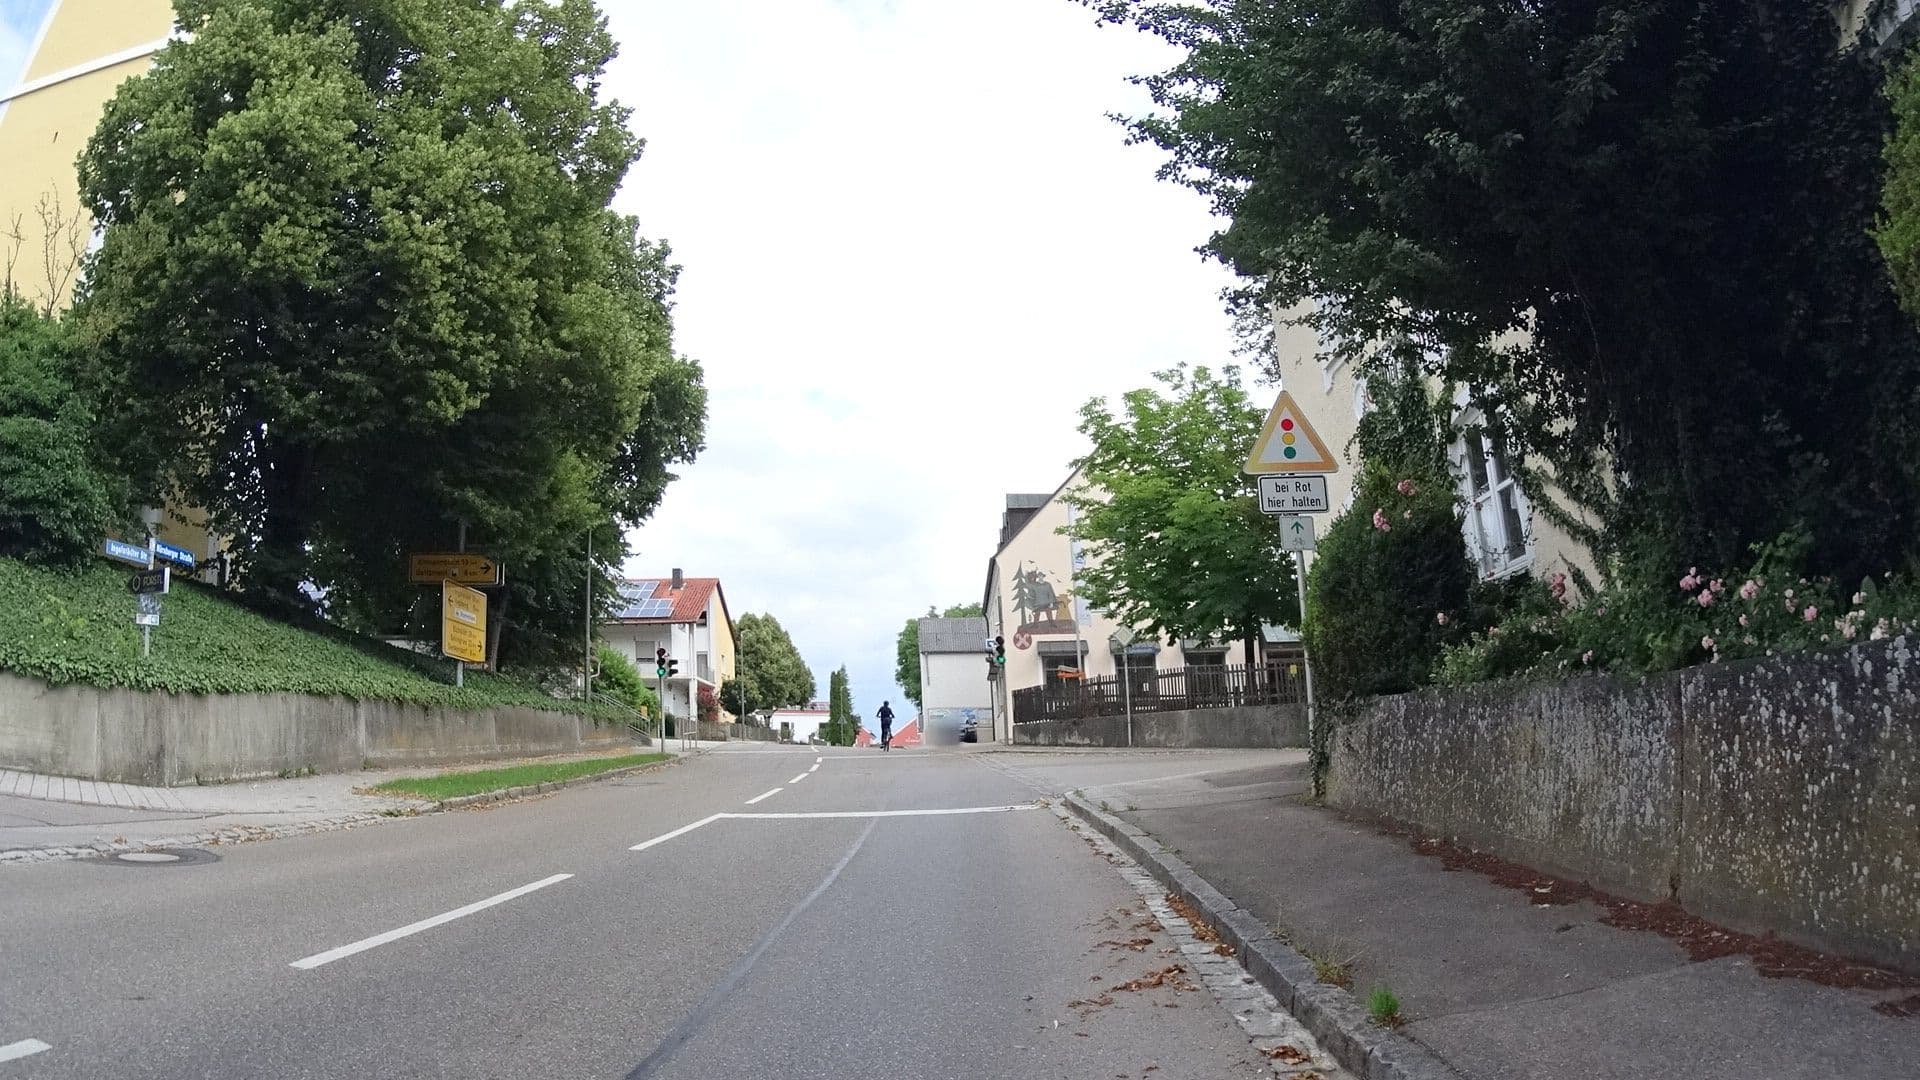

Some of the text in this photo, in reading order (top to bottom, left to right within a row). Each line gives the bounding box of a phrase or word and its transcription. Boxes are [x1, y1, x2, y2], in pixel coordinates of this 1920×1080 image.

[1275, 481, 1312, 493] bei Rot
[1267, 495, 1321, 508] hier halten
